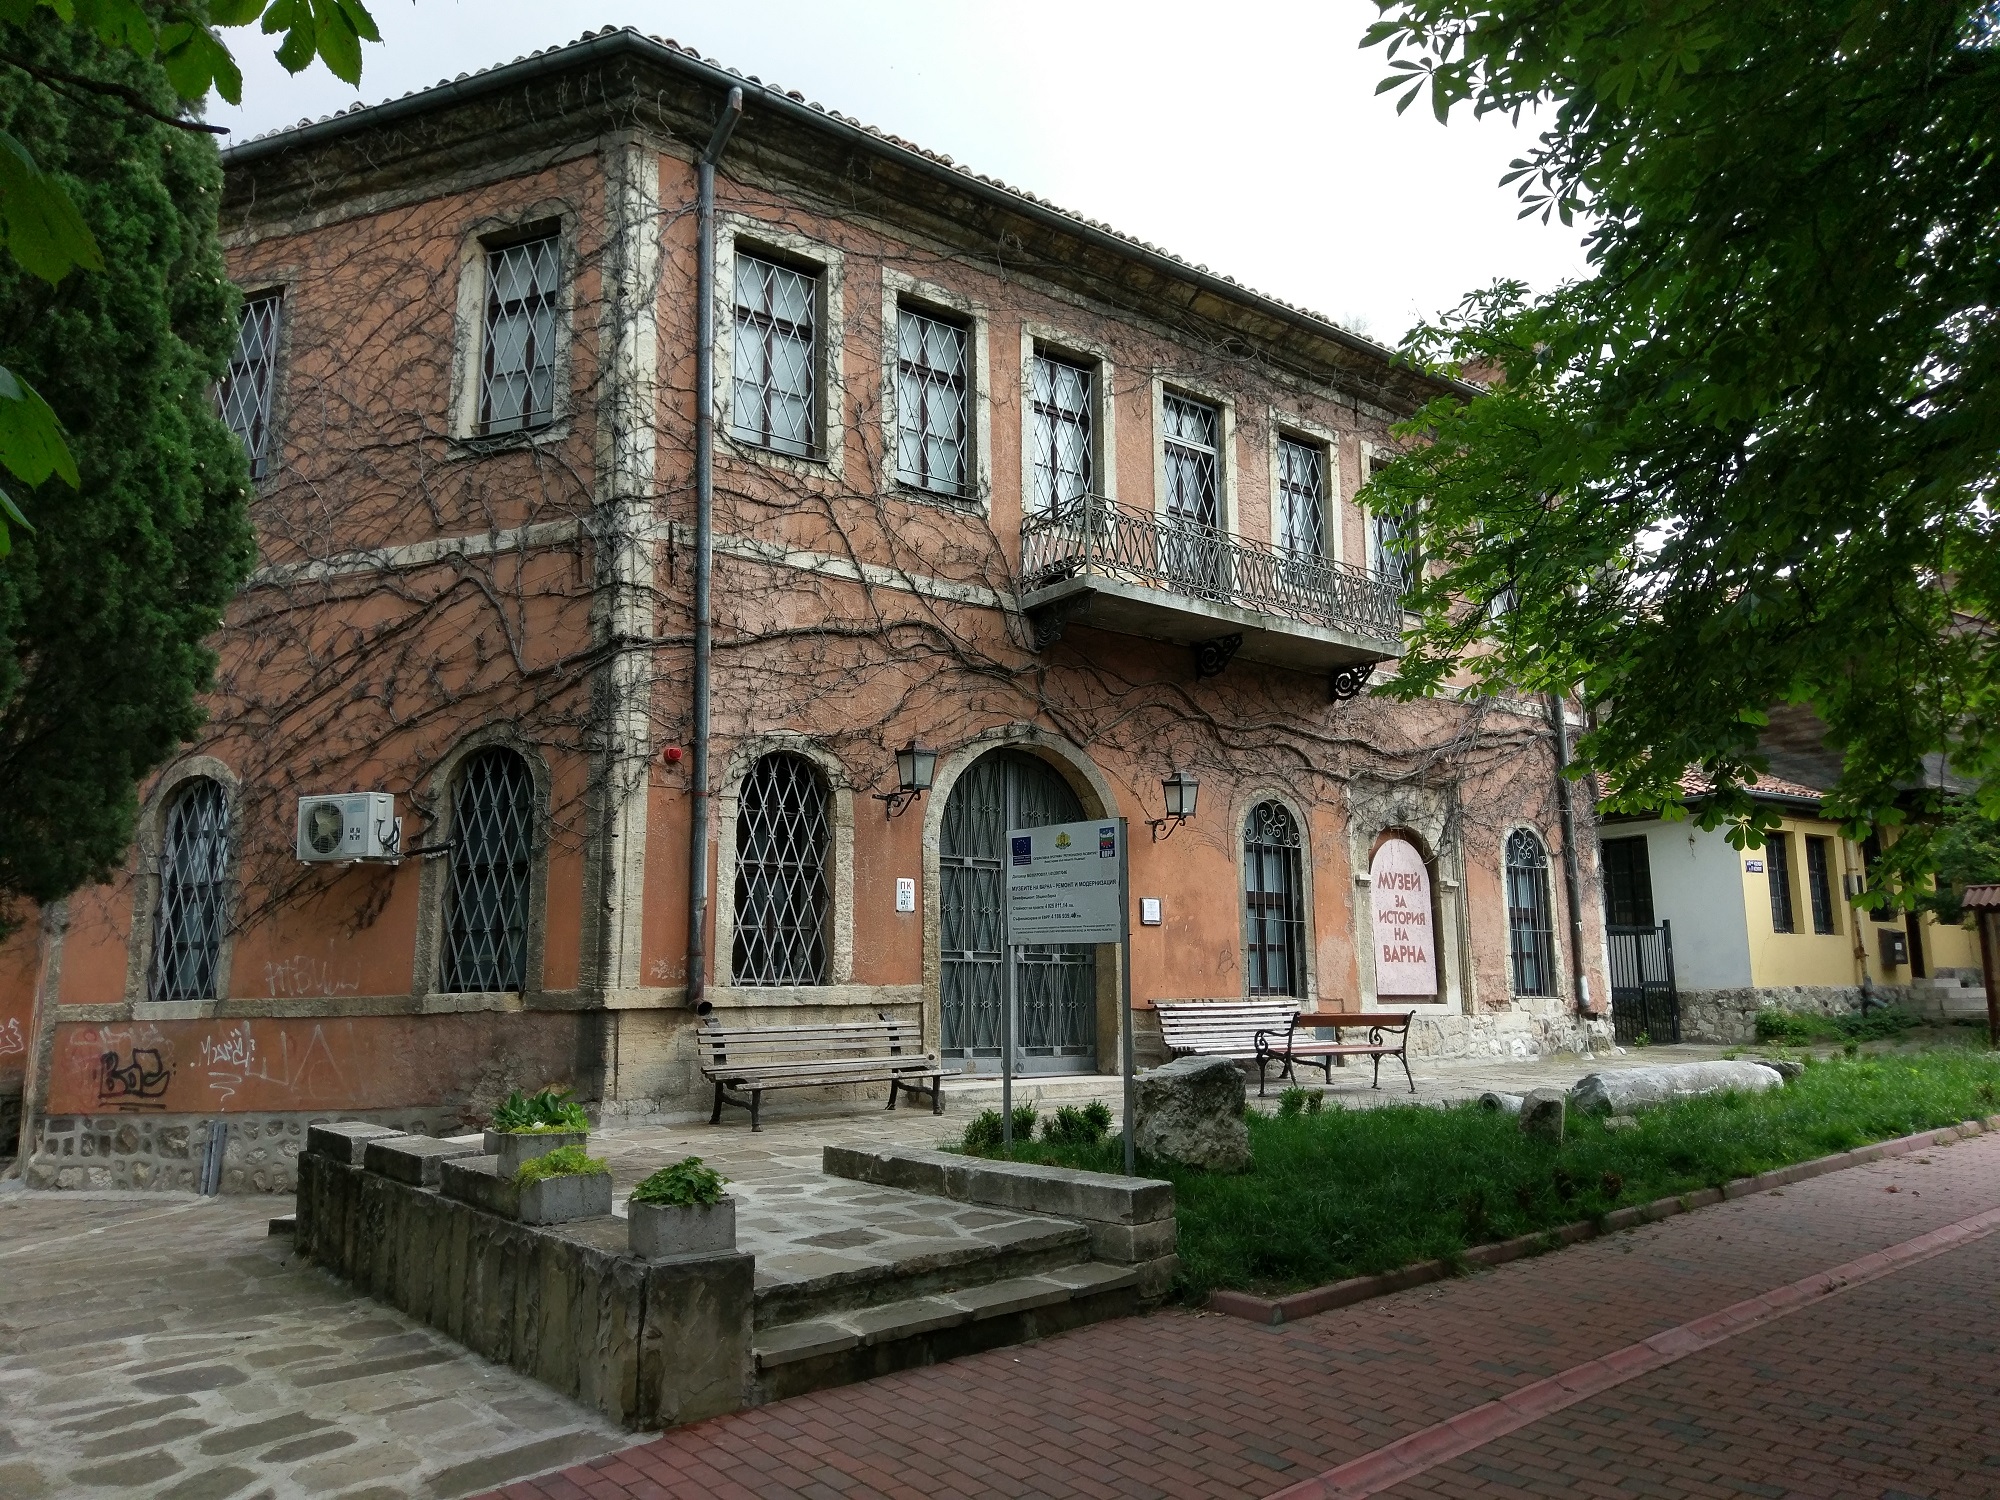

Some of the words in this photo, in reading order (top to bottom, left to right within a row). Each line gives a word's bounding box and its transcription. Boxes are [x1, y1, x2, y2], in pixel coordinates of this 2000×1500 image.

[1378, 872, 1421, 891] МУЗЕЙ
[1395, 895, 1407, 908] ЗА
[1379, 910, 1425, 925] ИСТОРИЯ
[1394, 928, 1409, 941] НА
[1383, 945, 1426, 963] ВАРНА
